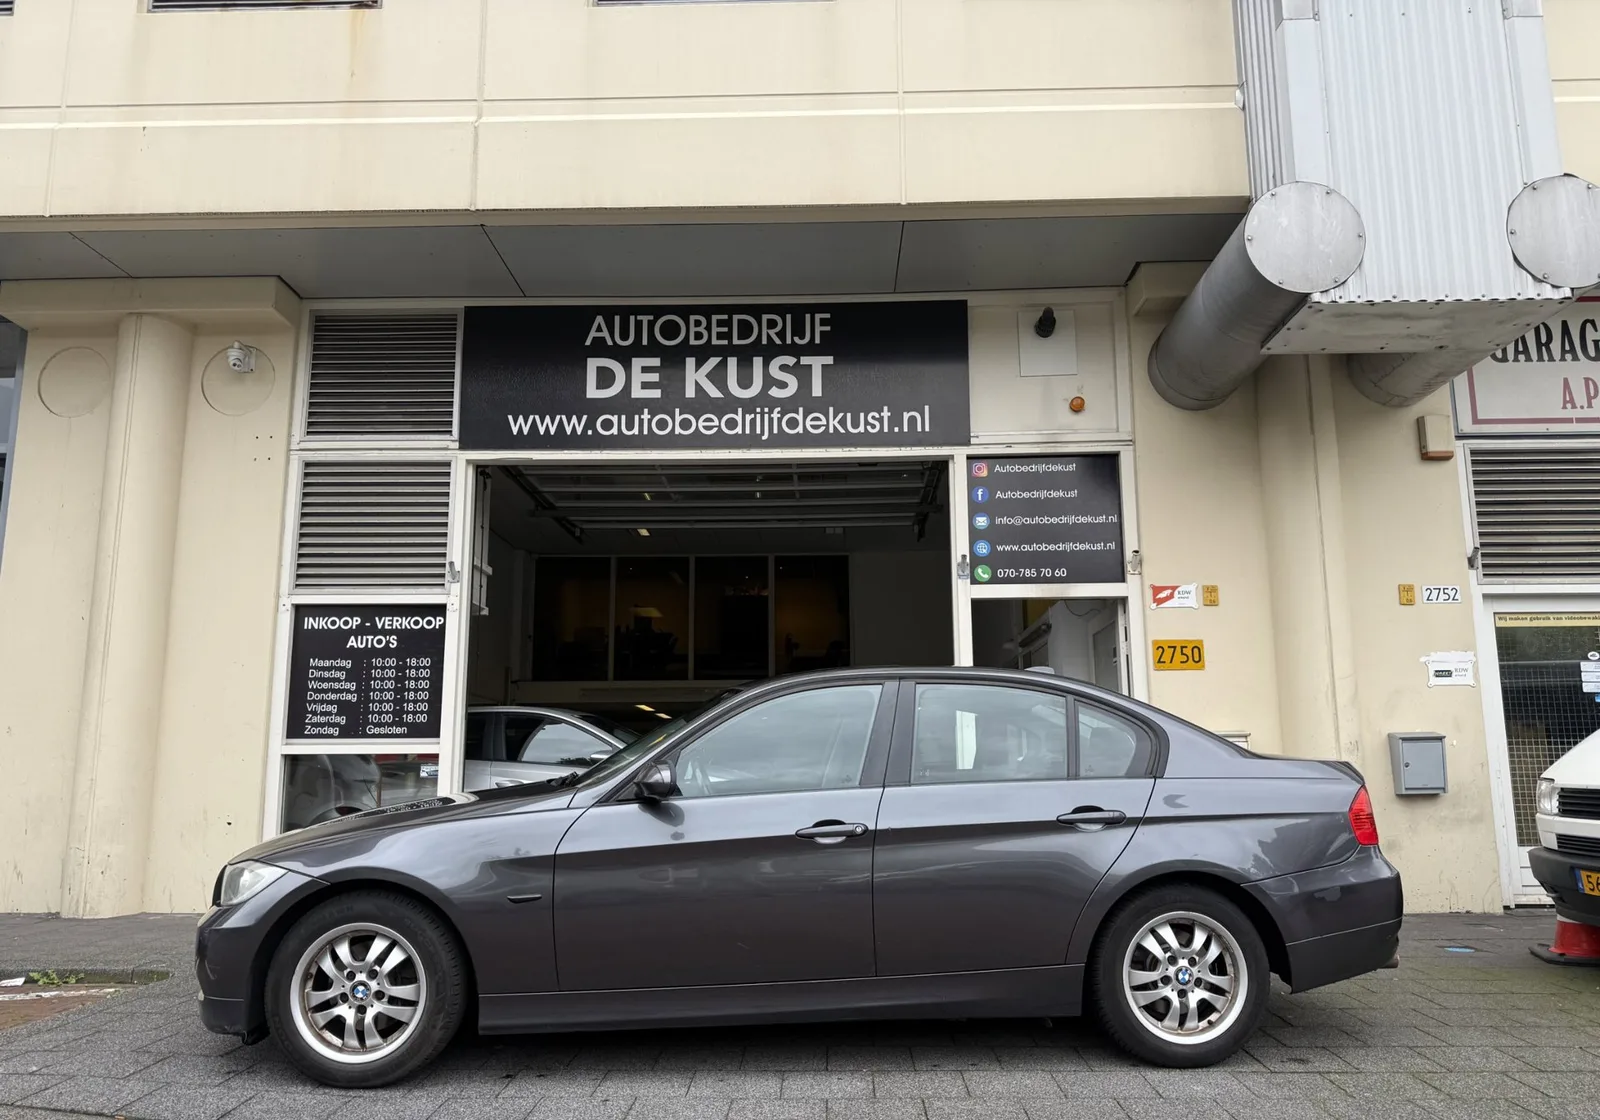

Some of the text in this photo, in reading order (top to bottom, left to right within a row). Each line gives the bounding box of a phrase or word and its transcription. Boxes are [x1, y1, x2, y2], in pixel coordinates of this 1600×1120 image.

[584, 313, 831, 347] AUTOBEDRIJF
[585, 355, 834, 399] DE KUST
[507, 404, 930, 441] www.autobedrijfdekust.nl
[994, 463, 1077, 473] Autobedrijfdekust
[995, 489, 1078, 500] Autobedrijfdekust
[995, 514, 1118, 526] info@autobedrijfdekust.nl
[996, 541, 1116, 553] www.autobedrijfdekust.nl
[997, 568, 1067, 578] 070-785 70 60
[1425, 587, 1459, 602] 2752
[304, 616, 362, 630] INKOOP
[375, 616, 445, 630] VERKOOP
[346, 635, 398, 649] AUTO'S
[1156, 645, 1202, 664] 2750
[309, 658, 352, 668] Maandag
[371, 657, 396, 666] 10:00
[405, 657, 431, 666] 18:00
[308, 669, 346, 680] Dinsdag
[370, 669, 395, 678] 10:00
[404, 669, 430, 678] 18:00
[308, 680, 356, 691] Woensdag
[370, 680, 394, 689] 10:00
[404, 680, 430, 689] 18:00
[307, 692, 357, 702] Donderdag
[369, 691, 394, 700] 10:00
[404, 691, 429, 700] 18:00
[306, 703, 337, 713] Vrijdag
[368, 702, 394, 711] 10:00
[402, 702, 428, 711] 18:00
[305, 714, 346, 724] Zaterdag
[368, 713, 392, 722] 10:00
[402, 713, 428, 722] 18:00
[304, 726, 339, 736] Zondag
[366, 725, 407, 734] Gesloten
